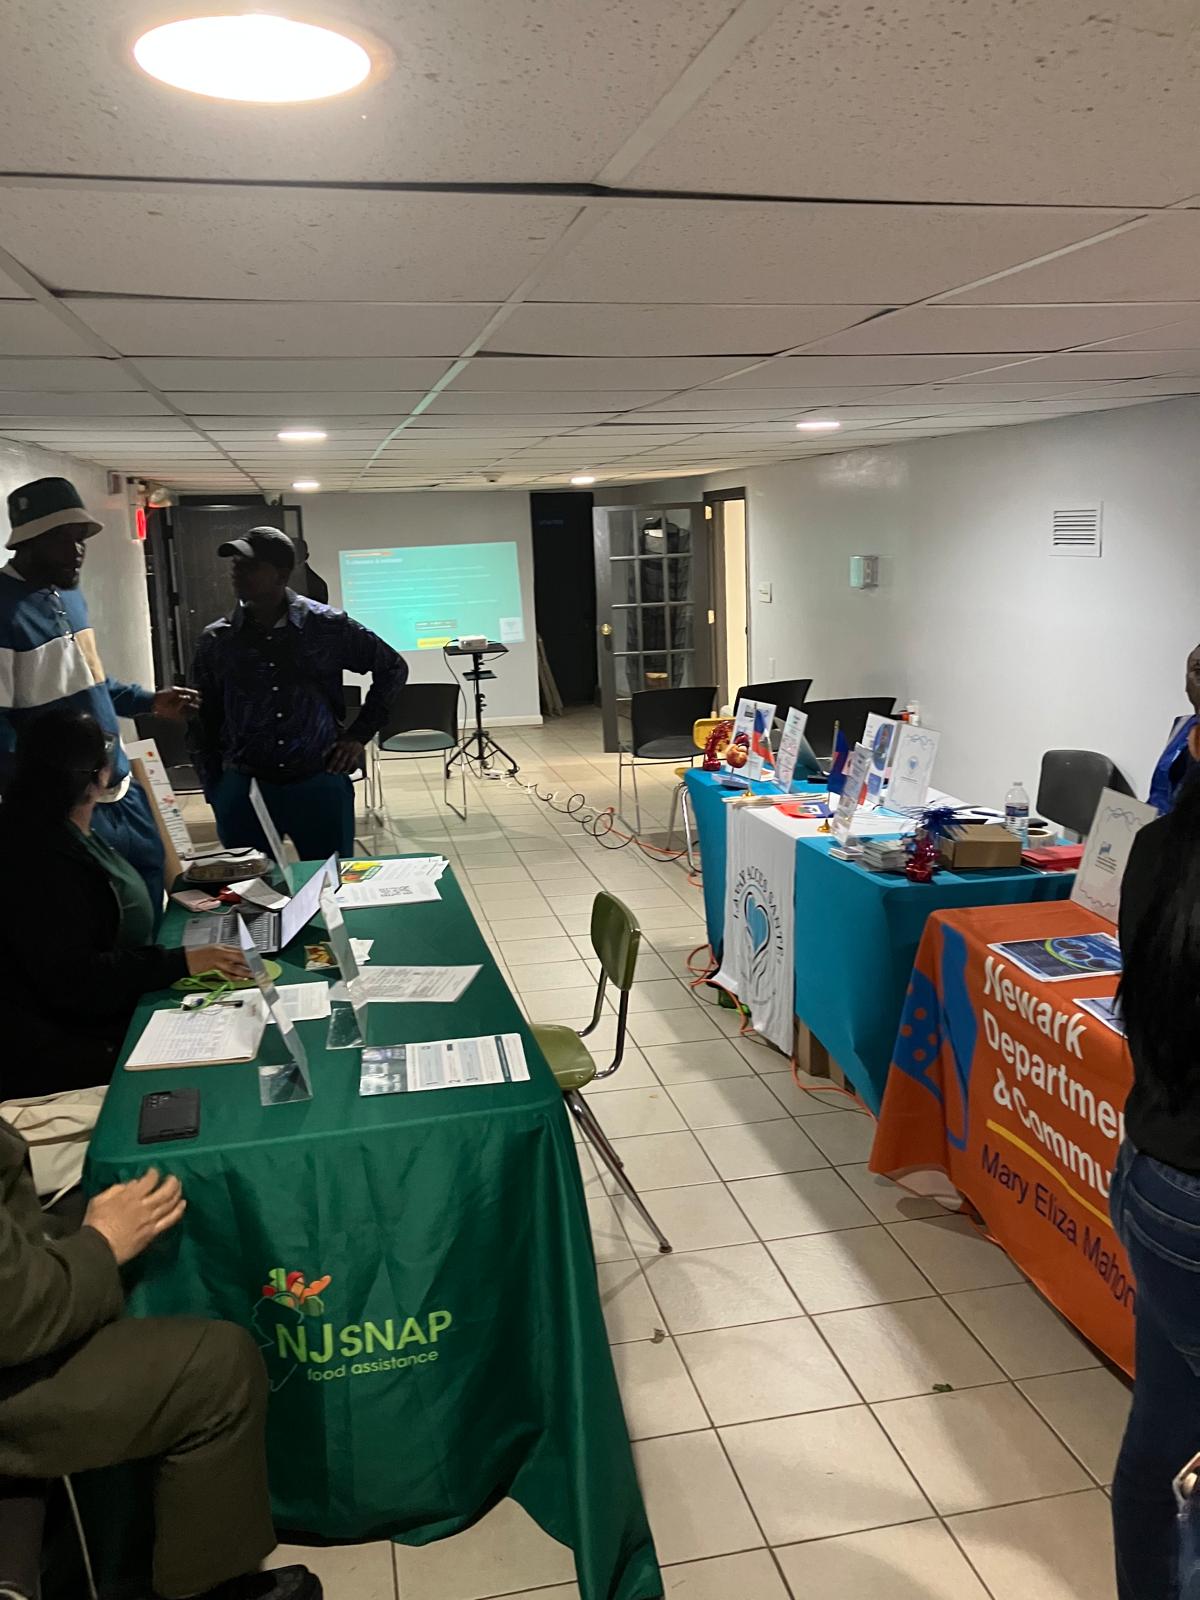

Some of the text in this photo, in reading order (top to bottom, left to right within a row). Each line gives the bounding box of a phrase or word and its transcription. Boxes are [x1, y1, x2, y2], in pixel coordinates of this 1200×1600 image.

[983, 956, 1087, 1060] Newark
[982, 1144, 1029, 1204] Mary
[1034, 1183, 1078, 1247] Eliza
[307, 1351, 440, 1382] food assistance
